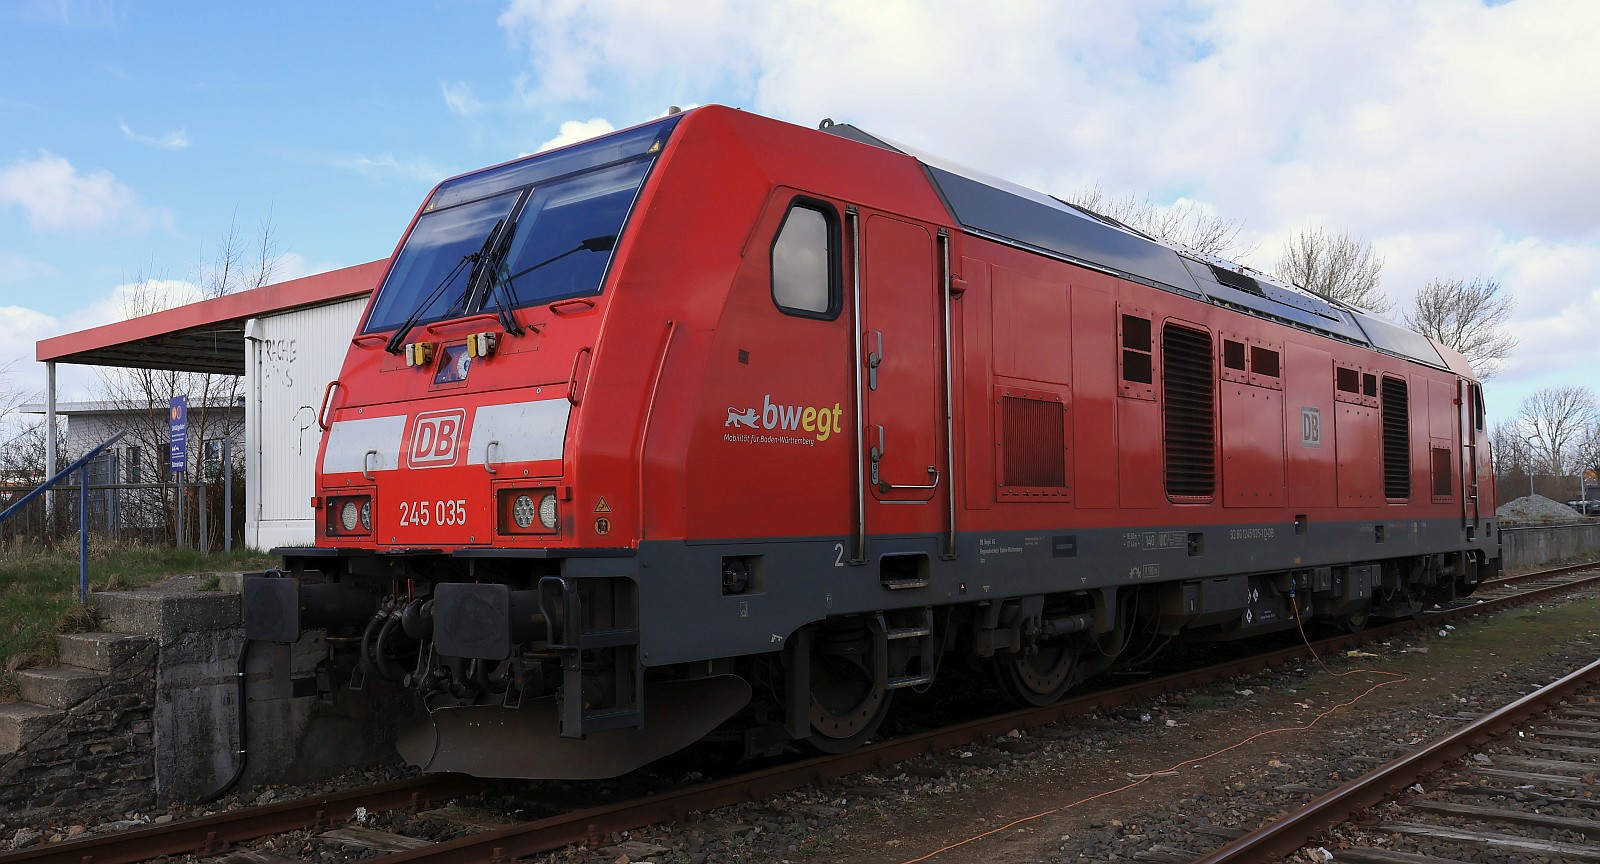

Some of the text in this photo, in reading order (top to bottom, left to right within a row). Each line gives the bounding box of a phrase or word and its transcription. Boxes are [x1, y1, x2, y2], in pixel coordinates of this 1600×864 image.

[762, 394, 843, 442] bwegt
[1303, 412, 1320, 442] DB
[414, 419, 456, 459] DB
[723, 433, 750, 443] Mobilität
[750, 434, 760, 444] für
[399, 499, 467, 526] 245 035
[834, 542, 844, 567] 2
